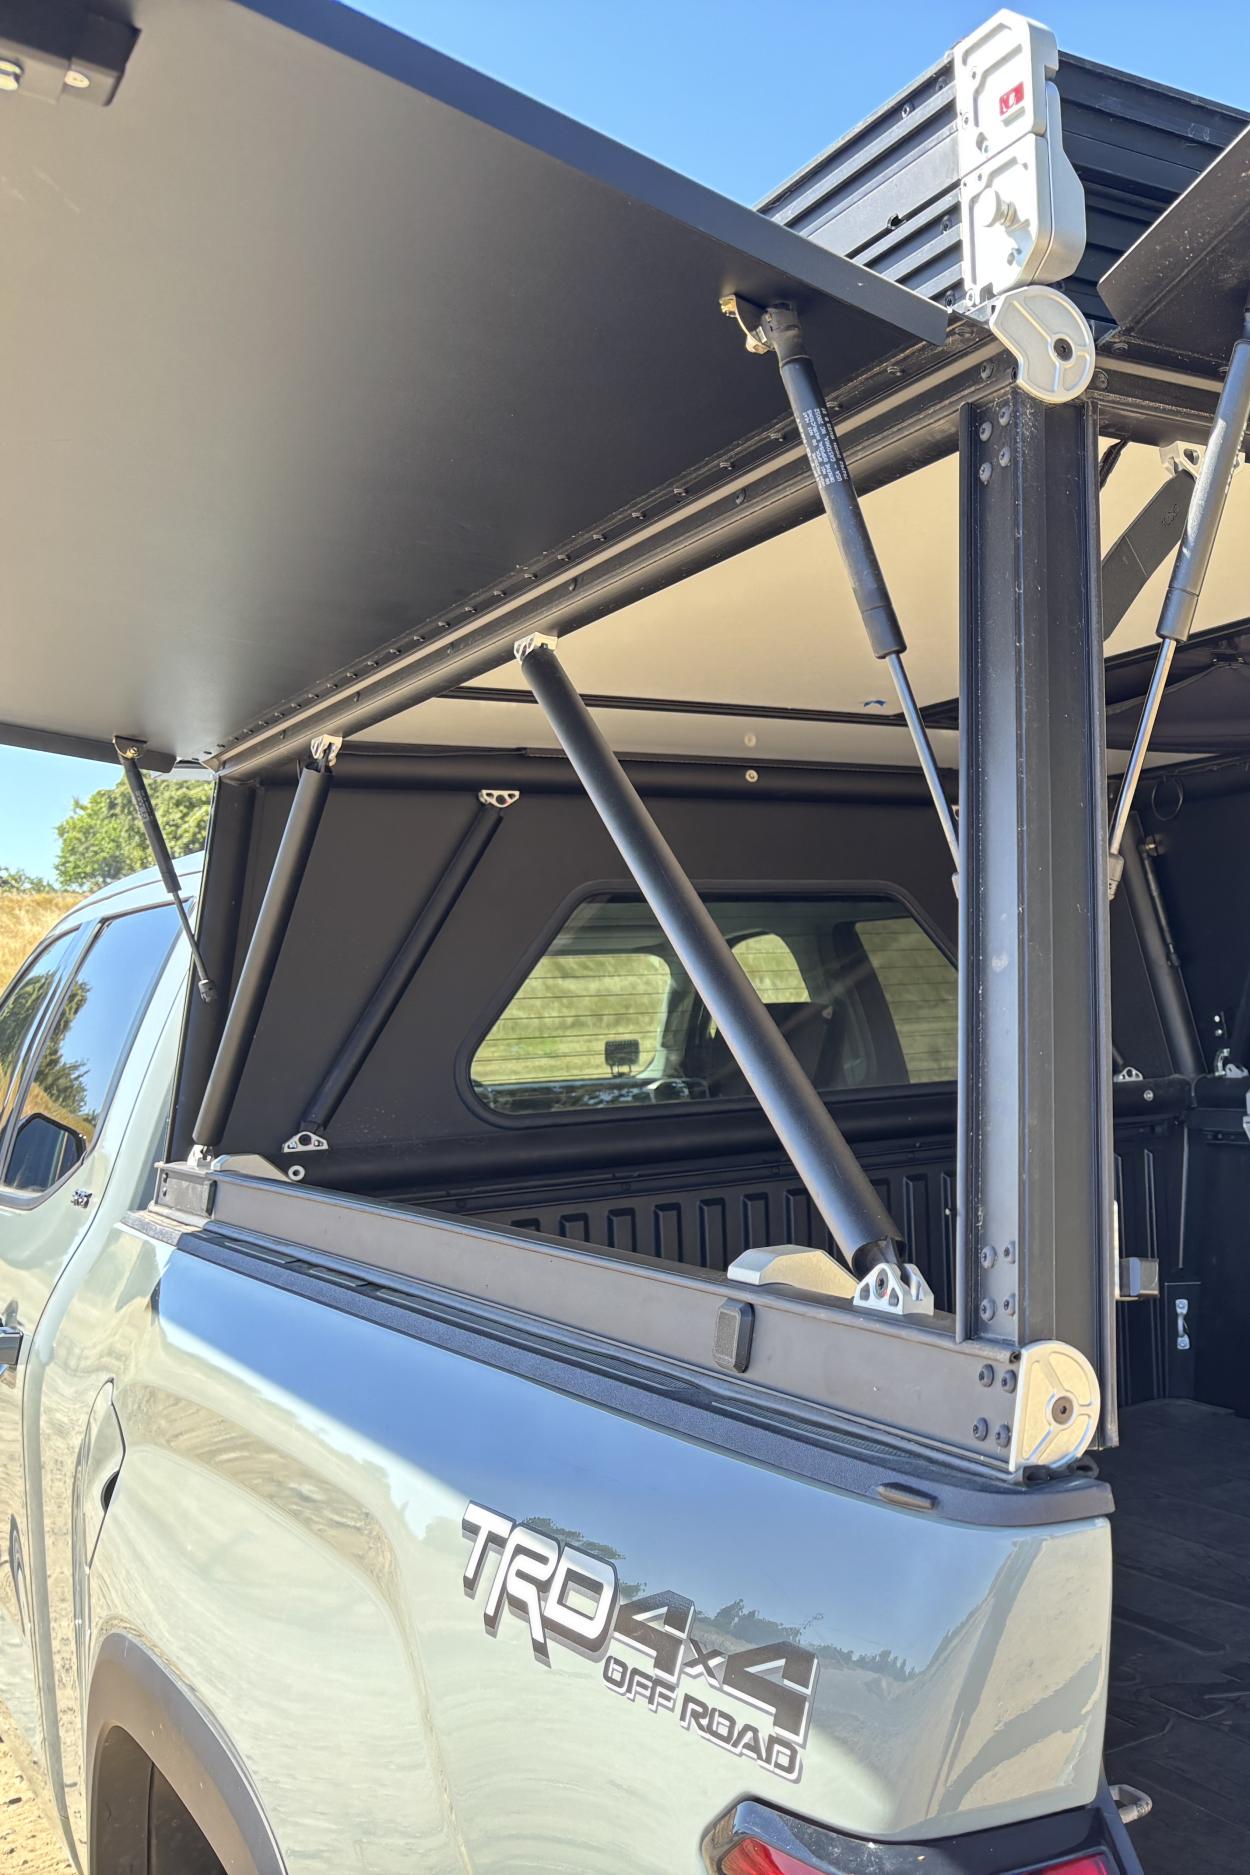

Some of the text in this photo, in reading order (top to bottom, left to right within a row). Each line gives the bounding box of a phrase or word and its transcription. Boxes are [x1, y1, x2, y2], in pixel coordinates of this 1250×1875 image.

[462, 1500, 621, 1664] TRD
[602, 1654, 803, 1783] OFF ROAD
